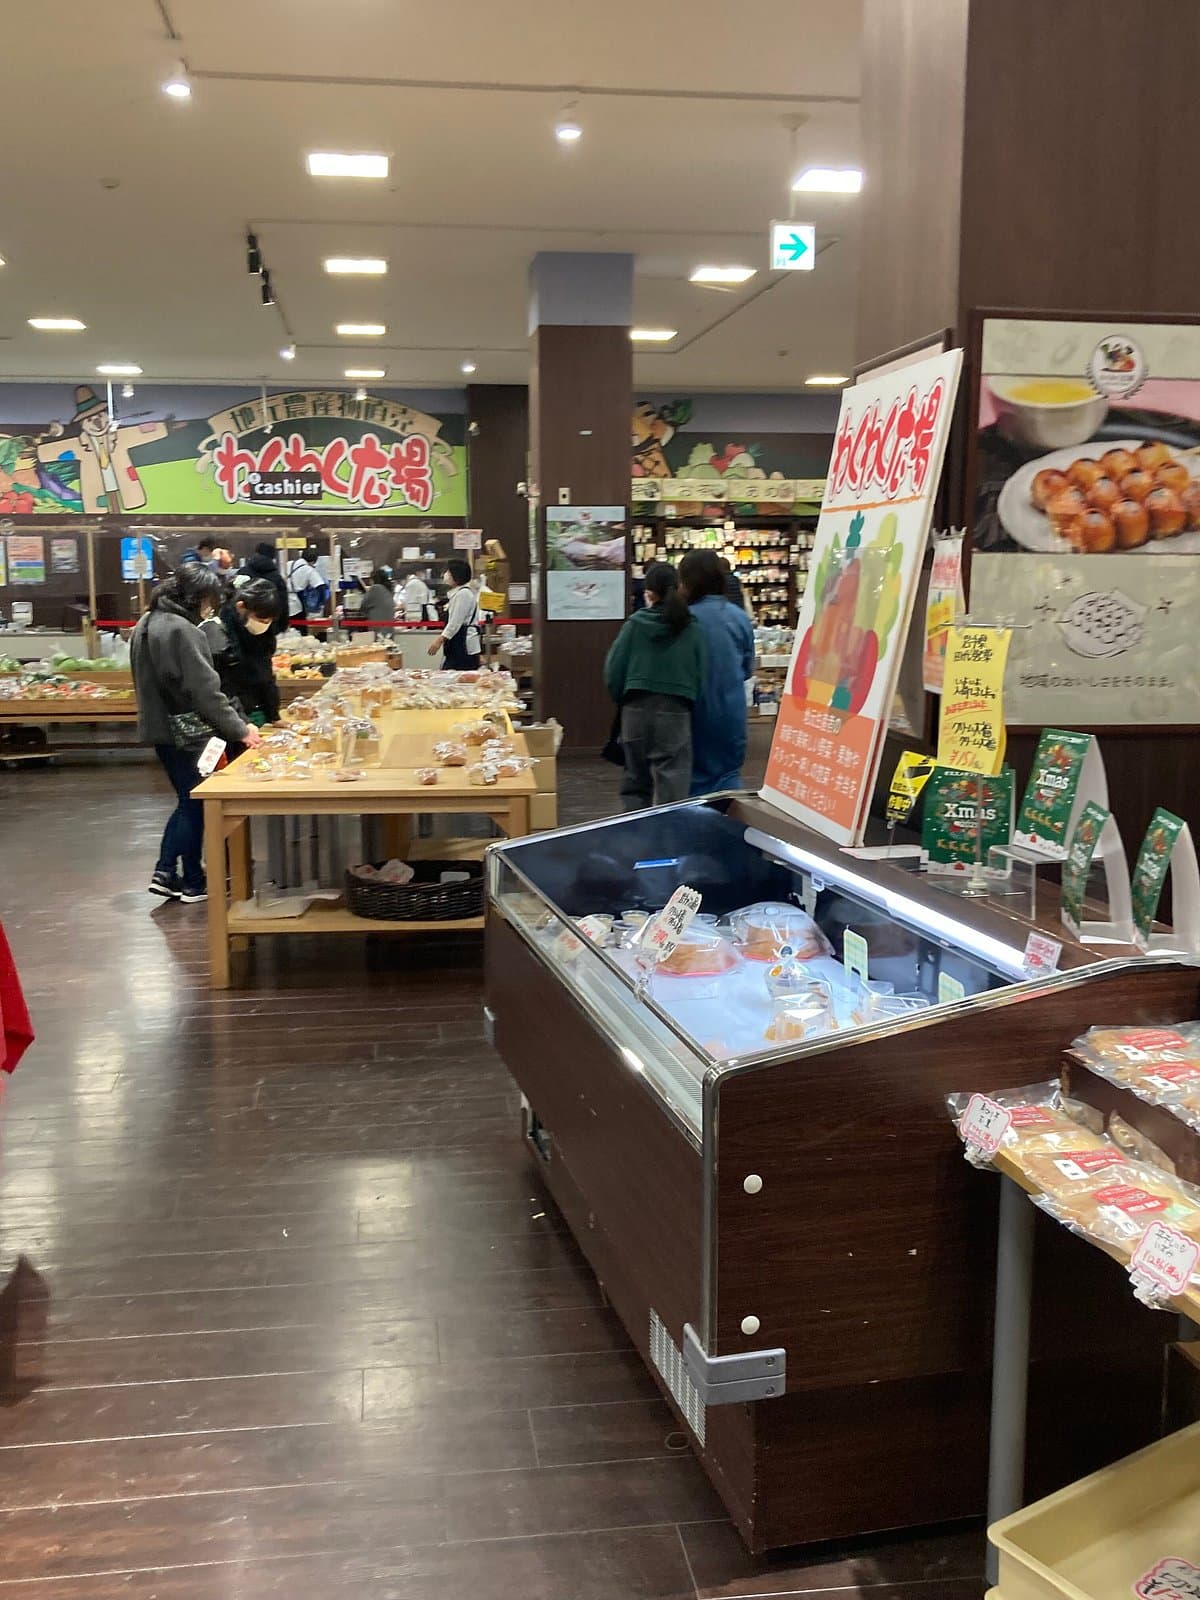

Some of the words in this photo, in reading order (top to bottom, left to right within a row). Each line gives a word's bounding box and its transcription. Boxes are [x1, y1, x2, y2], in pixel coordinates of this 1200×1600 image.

[829, 379, 943, 501] わくわく広場
[254, 478, 321, 495] cashier
